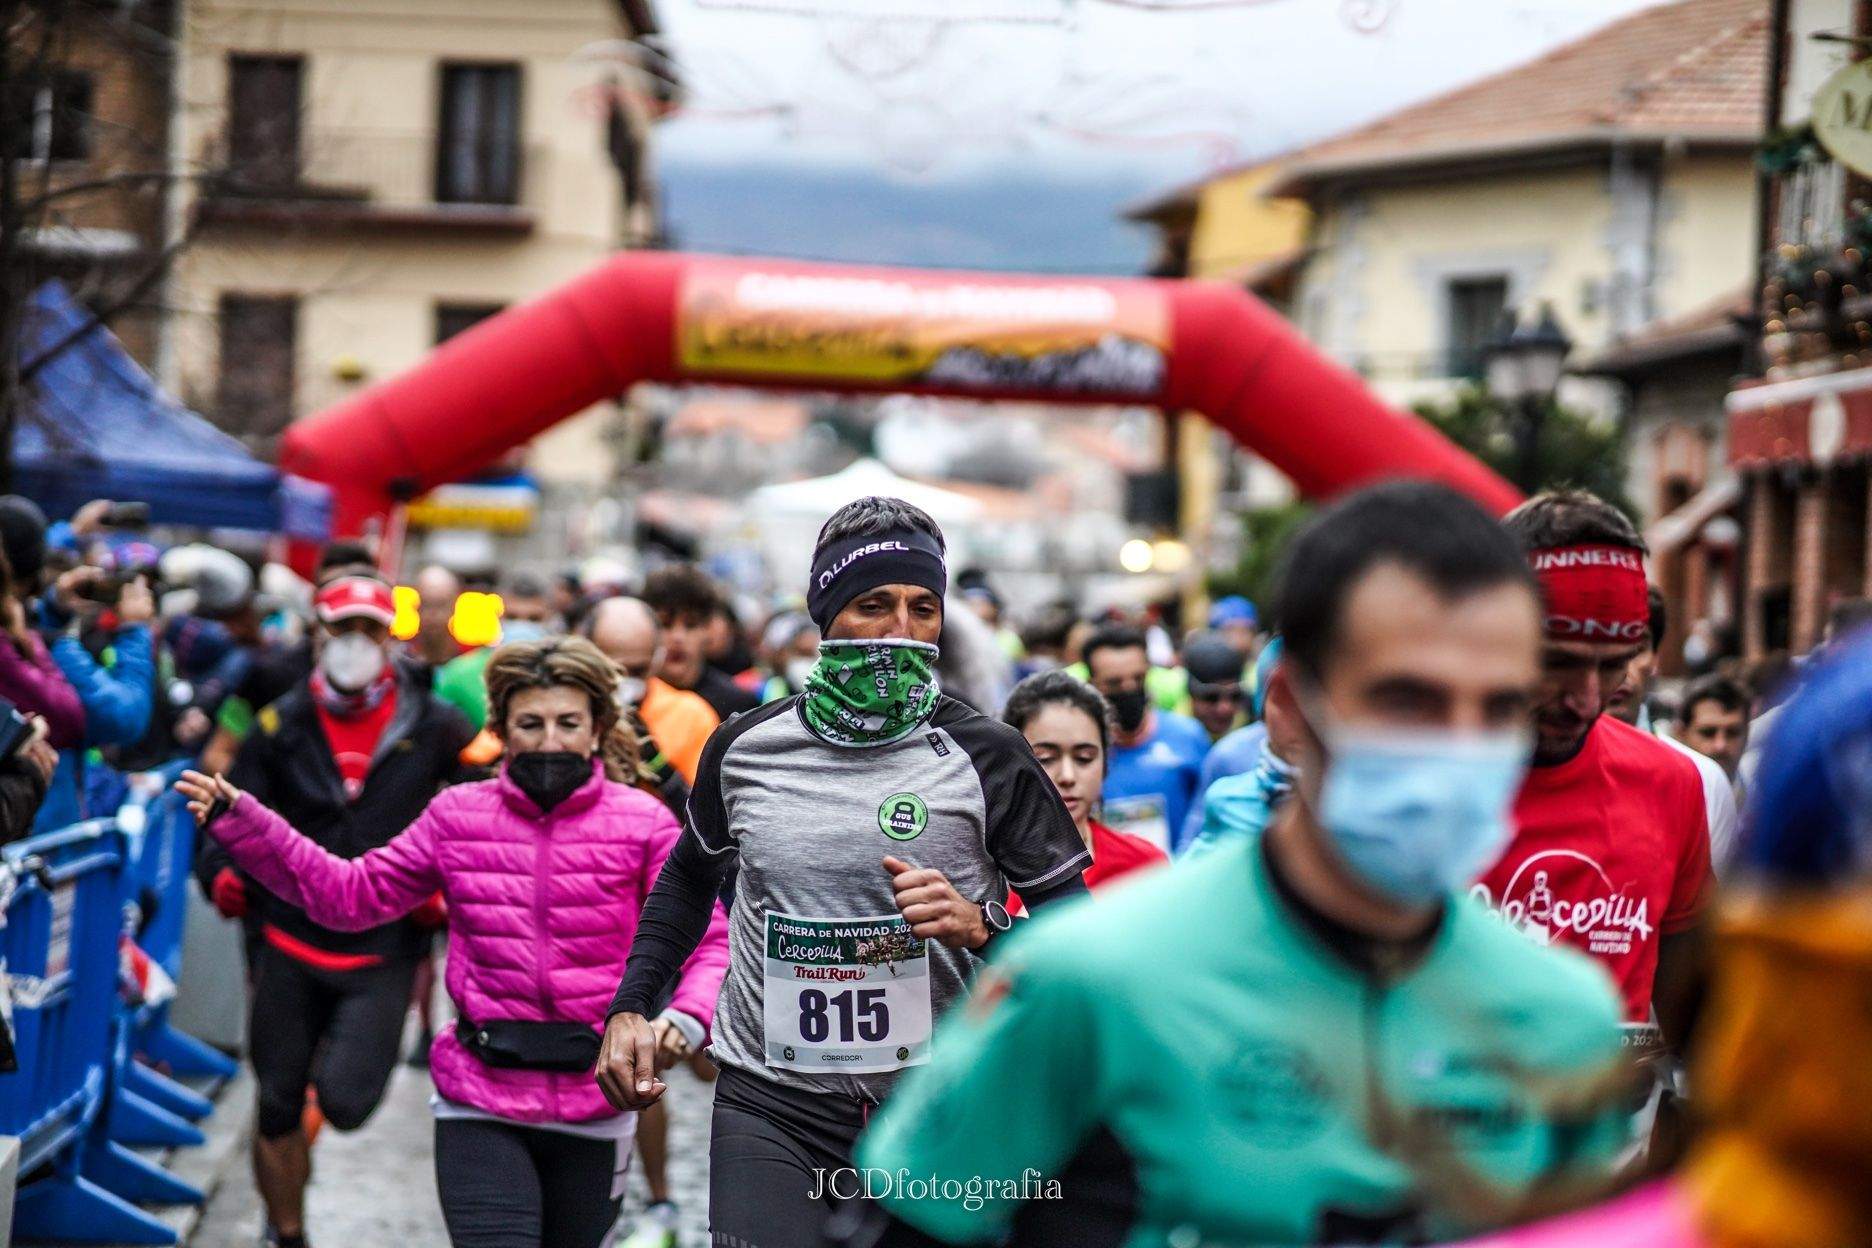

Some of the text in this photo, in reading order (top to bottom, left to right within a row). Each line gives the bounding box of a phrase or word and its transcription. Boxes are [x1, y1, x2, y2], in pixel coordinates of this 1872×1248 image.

[832, 541, 909, 575] LURBEL
[895, 812, 912, 820] GUS
[773, 921, 817, 937] CARRERA
[819, 929, 832, 938] DE
[834, 926, 890, 938] NAVIDAD
[798, 988, 890, 1042] 815
